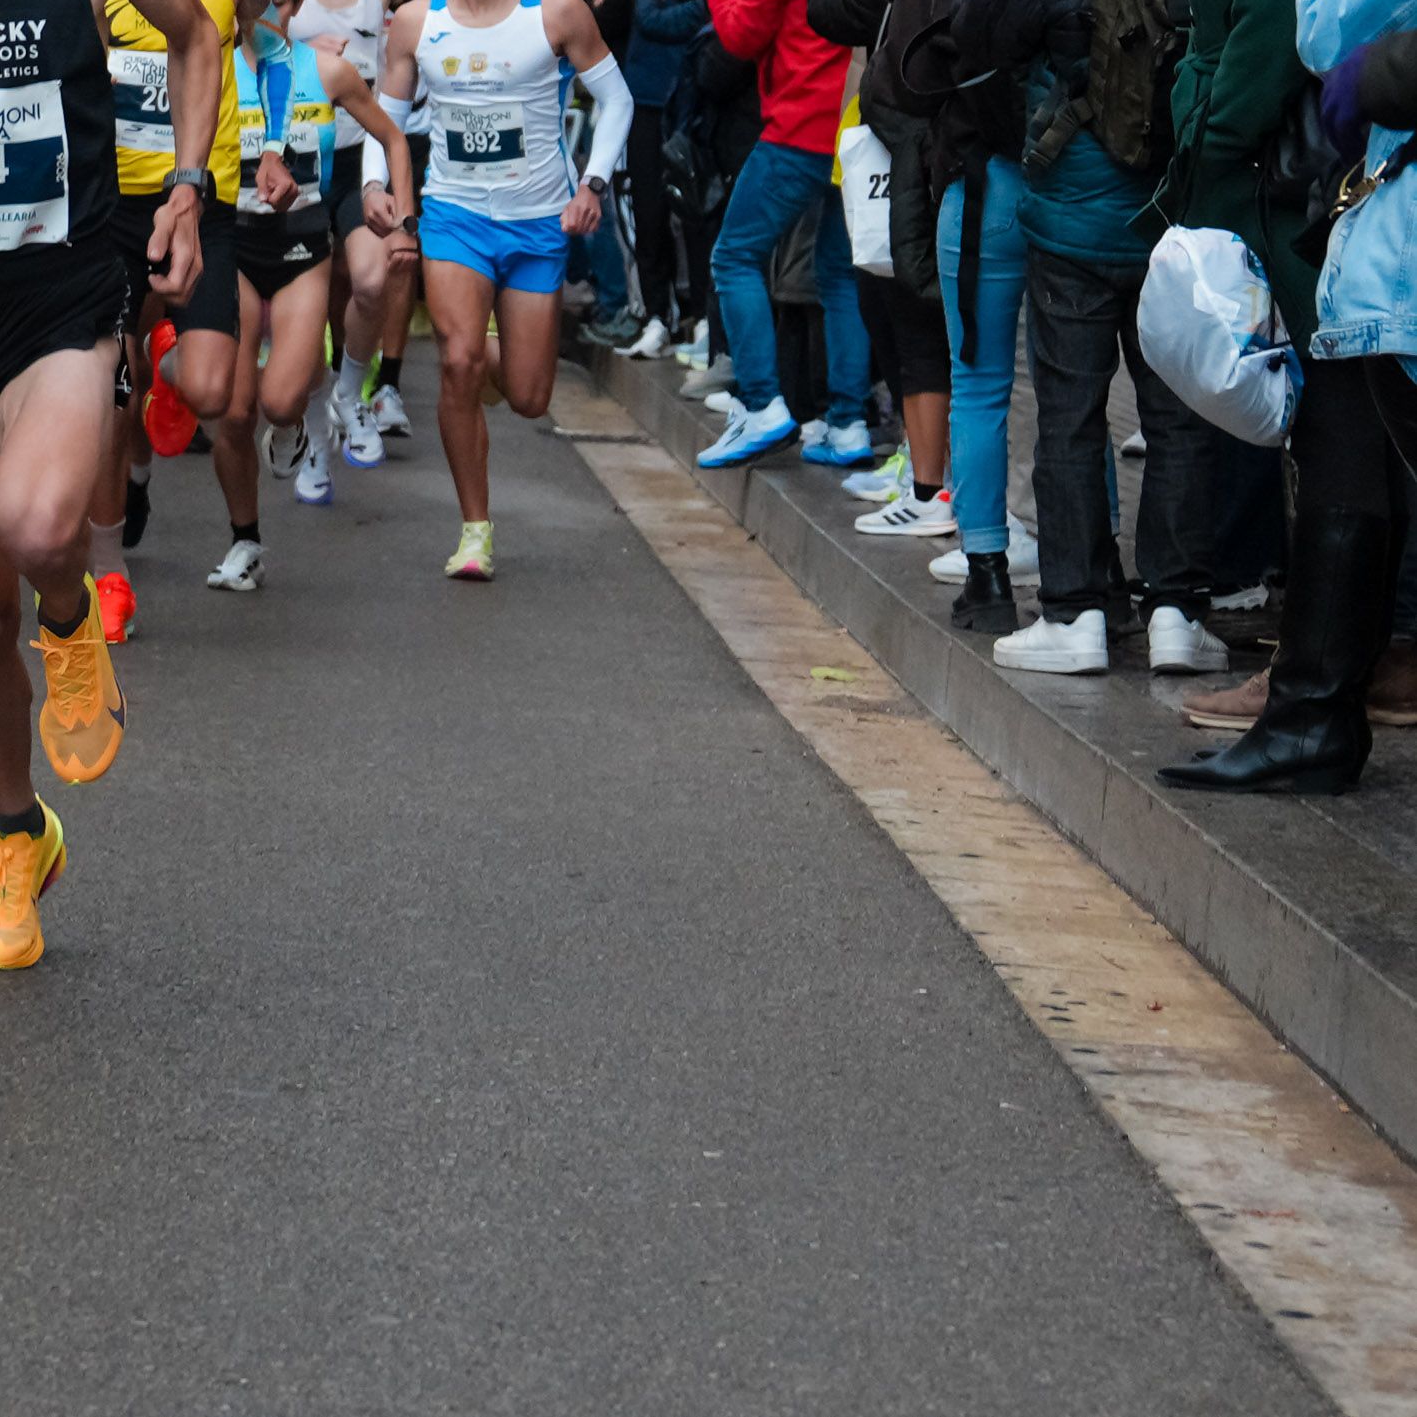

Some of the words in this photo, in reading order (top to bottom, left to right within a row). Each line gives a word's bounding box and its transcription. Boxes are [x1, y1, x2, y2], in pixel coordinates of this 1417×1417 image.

[141, 85, 170, 113] 20
[451, 110, 511, 123] PATRIMONI
[463, 129, 502, 153] 892
